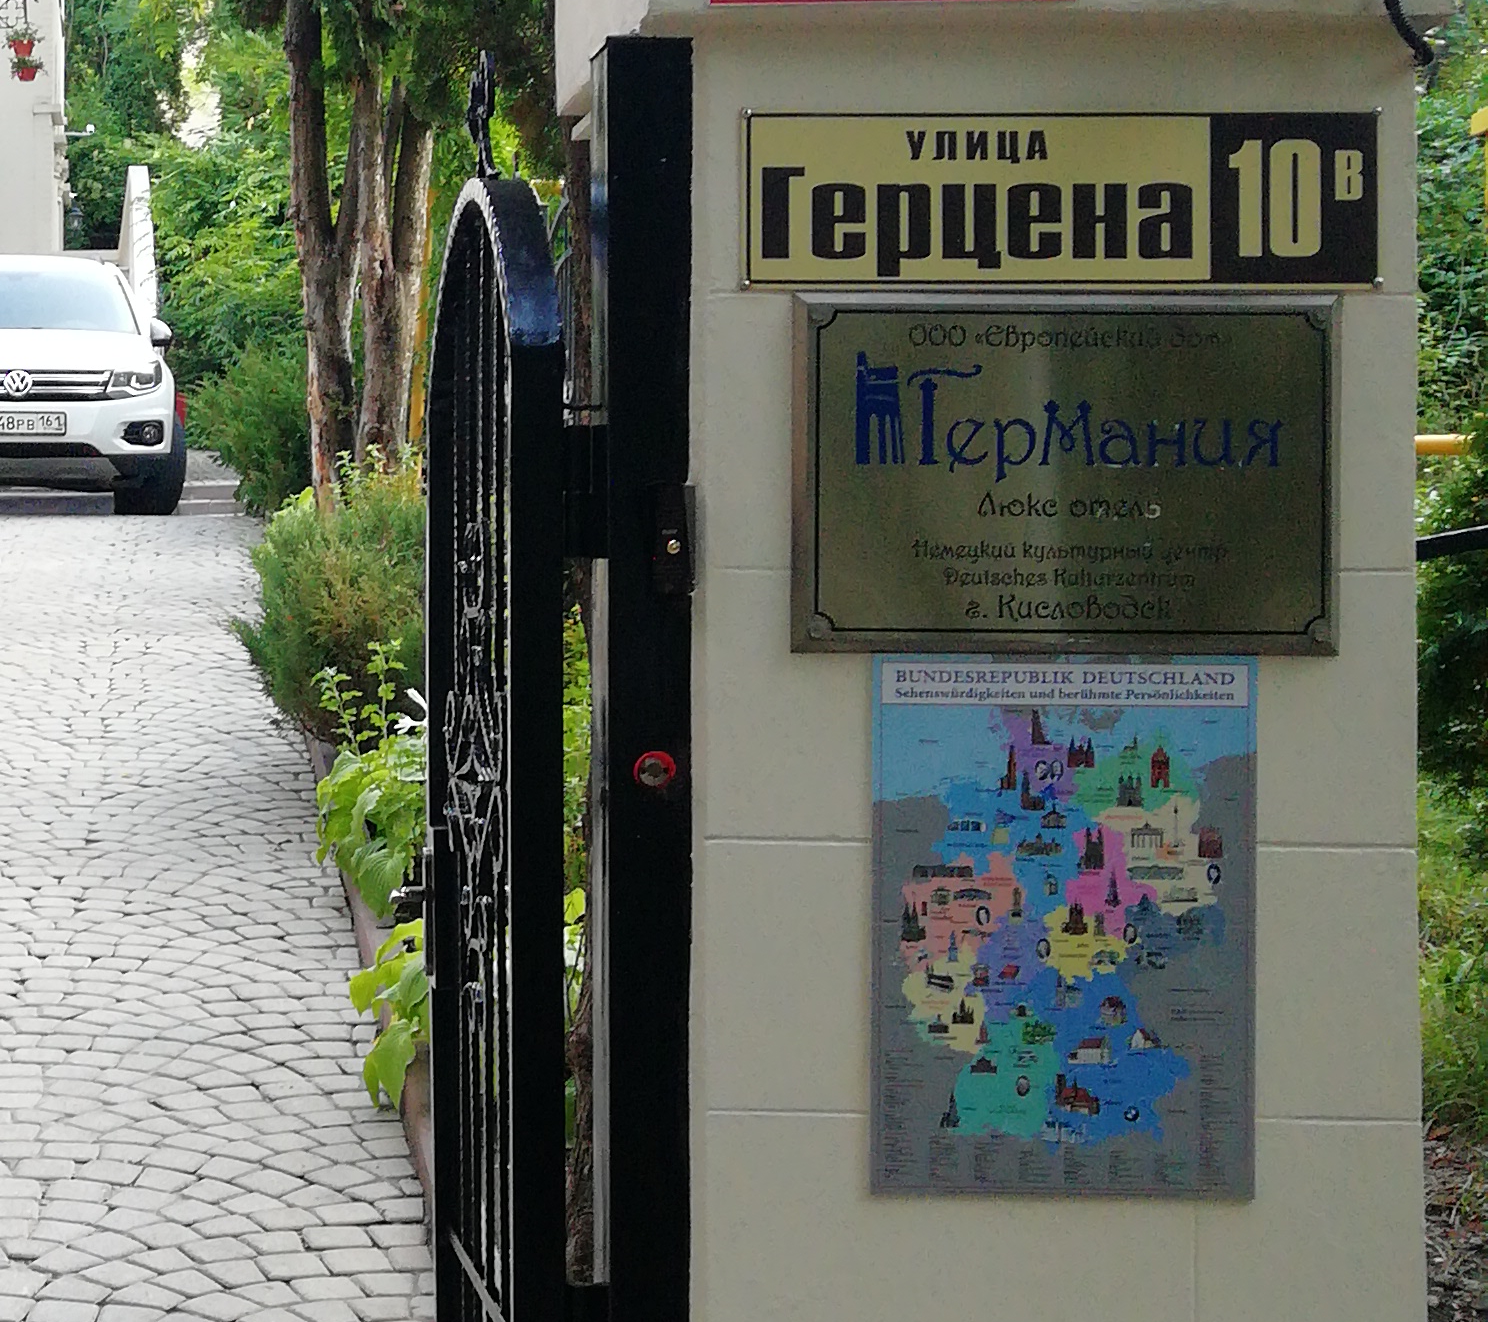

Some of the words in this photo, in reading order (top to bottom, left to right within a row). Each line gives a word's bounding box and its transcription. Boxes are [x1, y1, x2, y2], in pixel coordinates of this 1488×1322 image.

[906, 130, 1049, 162] УЛИЦА
[761, 167, 1194, 277] Герцена
[909, 323, 967, 347] ООО
[977, 490, 1058, 517] Люкс
[1069, 494, 1161, 518] отель
[911, 538, 1017, 564] Немецкий
[1022, 538, 1154, 564] культурный
[942, 567, 1047, 587] Deutsches
[964, 599, 989, 620] г.
[997, 594, 1172, 621] Кисловодск
[896, 669, 1074, 685] BUNDESREPUBLIK
[1082, 669, 1235, 686] DEUTSCHLAND
[895, 687, 1025, 701] Sehenswürdigkeiten
[1029, 687, 1055, 699] und
[1058, 687, 1122, 700] berühmte
[1125, 687, 1234, 701] Persönlichkeiten
